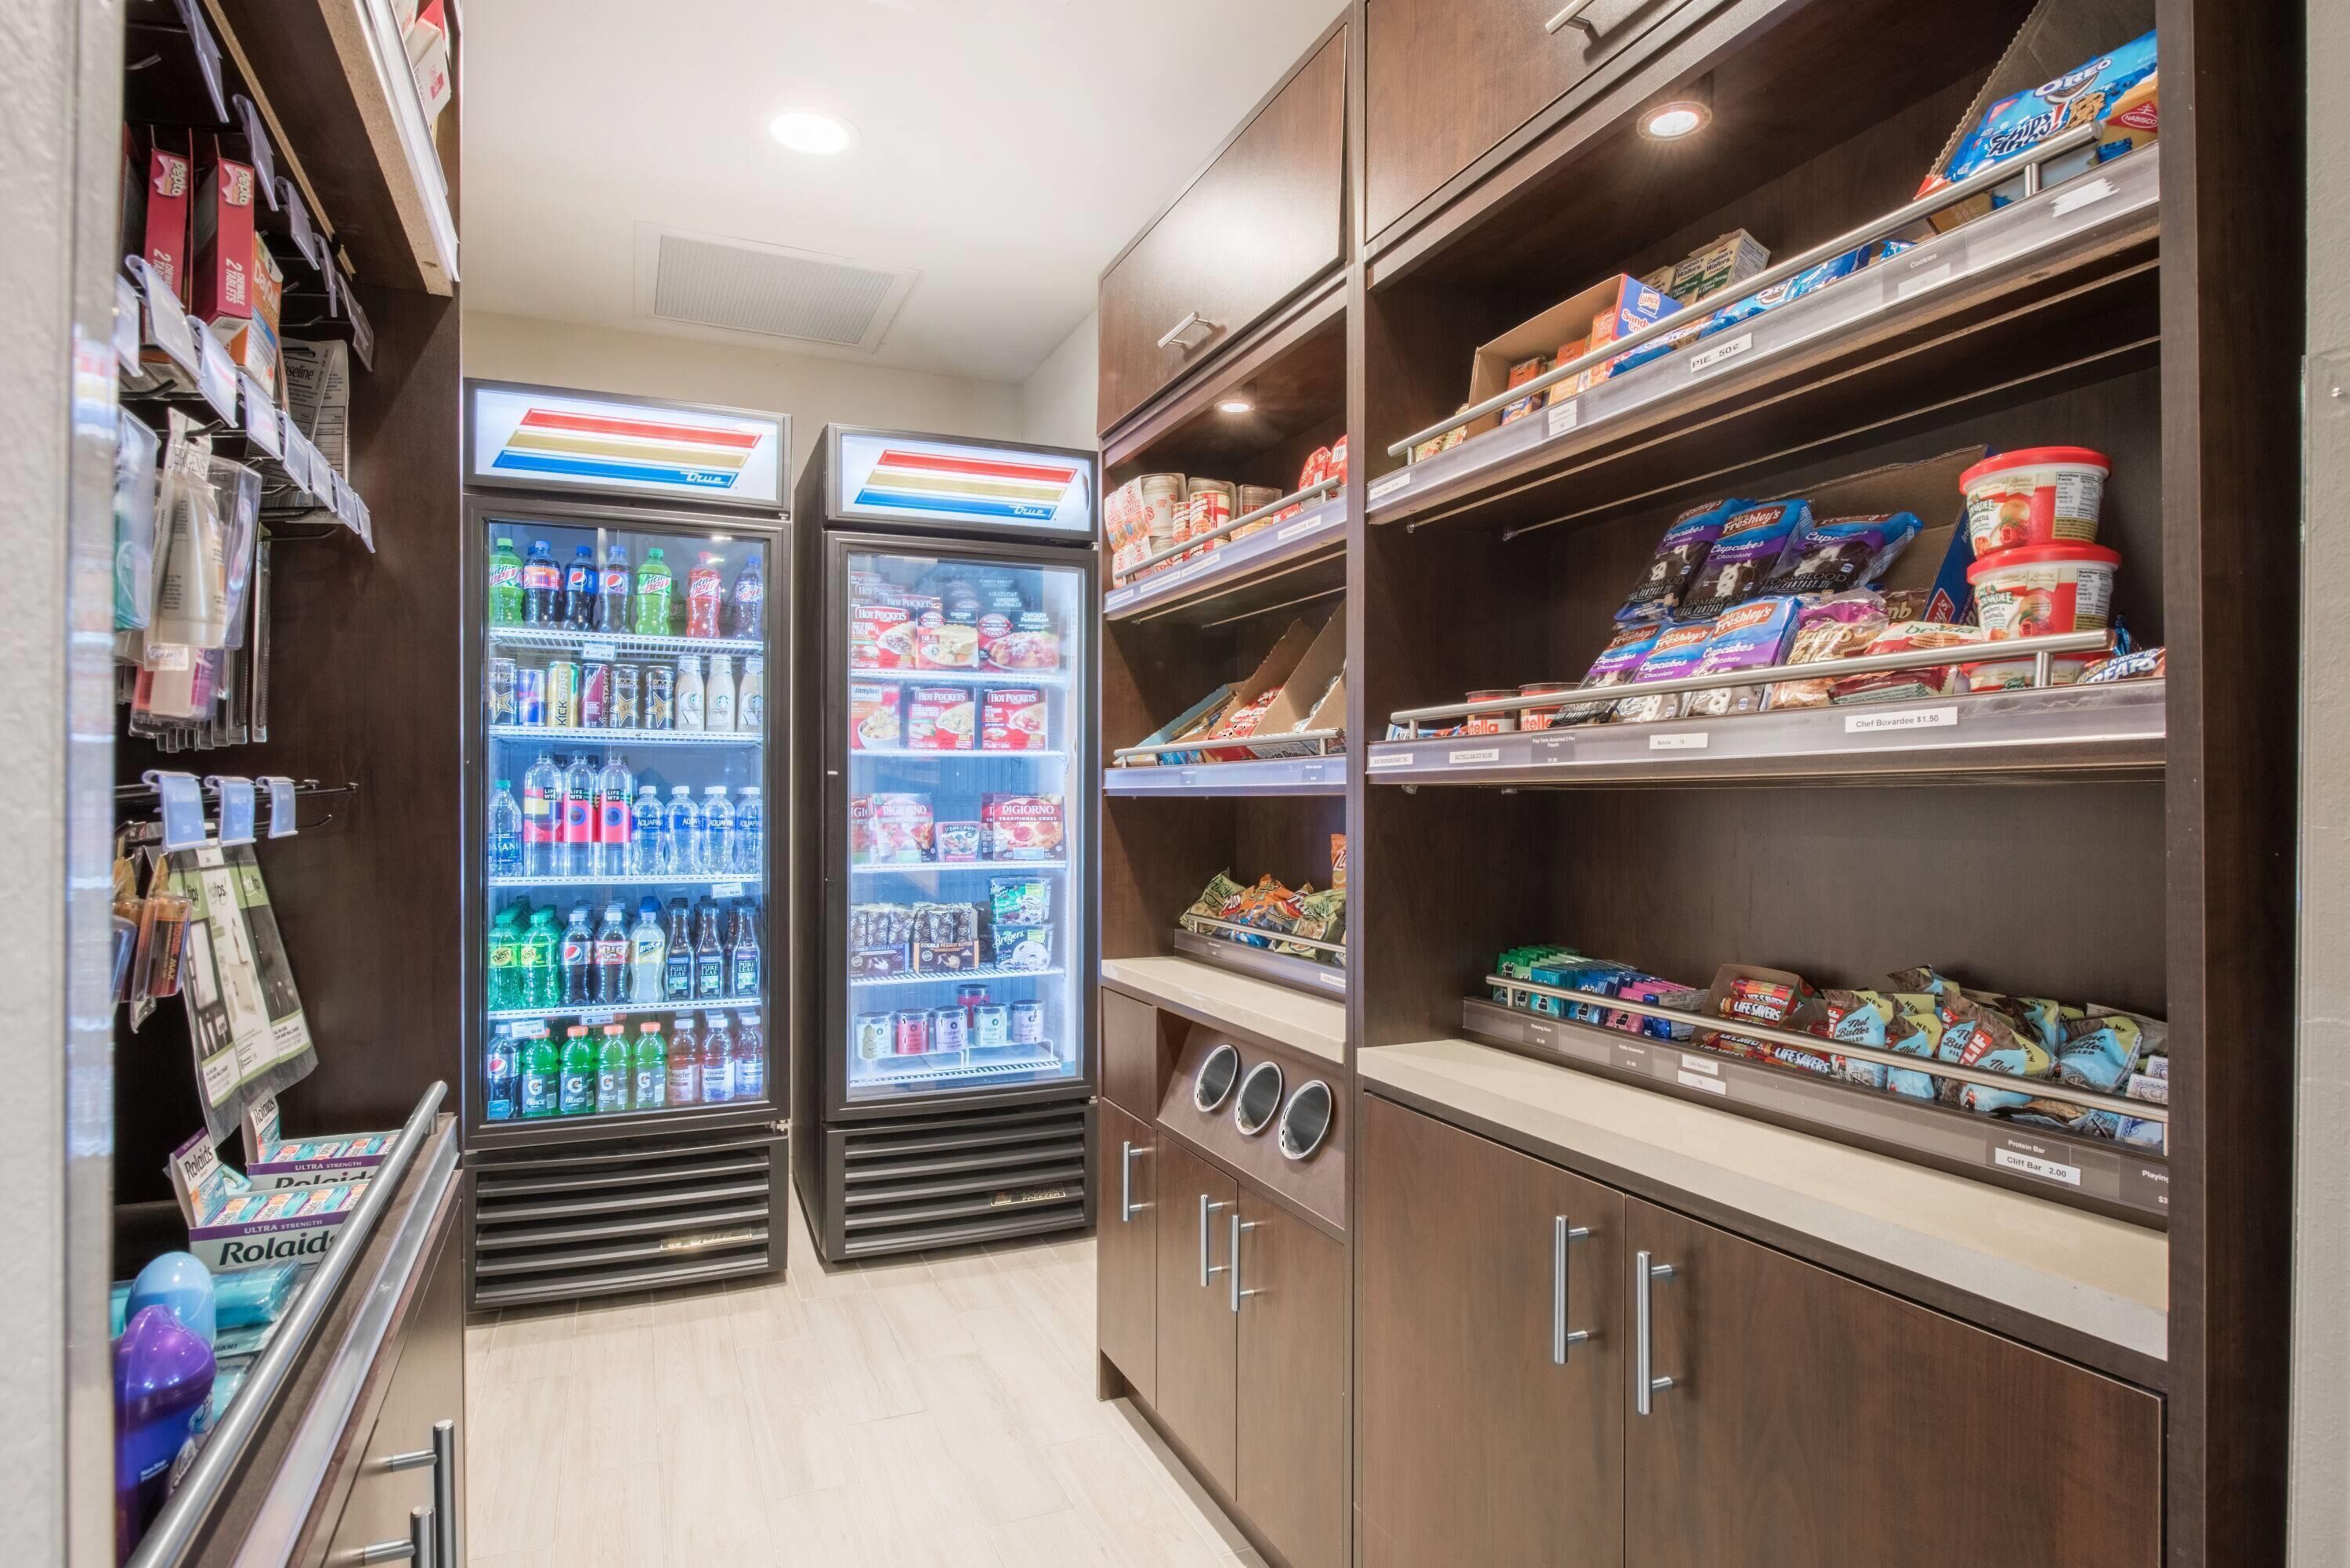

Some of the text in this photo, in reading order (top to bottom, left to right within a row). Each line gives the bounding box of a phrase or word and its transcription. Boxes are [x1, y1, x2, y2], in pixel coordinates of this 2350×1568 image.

[2033, 59, 2113, 98] OREO
[2124, 114, 2158, 125] NABISCO
[1910, 253, 1937, 269] Cookies
[1692, 355, 1712, 368] PIE
[1723, 509, 1781, 534] Freshley's
[1663, 526, 1705, 542] Cupcakes
[1710, 540, 1765, 555] Cupcakes
[1716, 551, 1752, 560] Chocolate
[902, 598, 933, 608] POCKETS
[877, 610, 907, 621] POCKETS
[1715, 607, 1772, 633] Freshley's
[1653, 630, 1708, 651] Freshley's
[1702, 642, 1755, 659] Cupcakes
[1595, 652, 1637, 665] Cupcakes
[1640, 659, 1687, 672] Cupcakes
[1643, 670, 1675, 679] Chocolate
[934, 692, 966, 702] POCKETS
[990, 693, 1037, 703] HOT POCKETS
[1856, 714, 1940, 728] Chef Boyardee $1.50
[637, 818, 663, 827] AQUAFINA
[709, 818, 734, 827] AQUAFINA
[1865, 996, 1884, 1010] NEW
[1904, 1000, 1922, 1015] NEW
[1847, 1017, 1871, 1028] Nut
[1836, 1027, 1871, 1039] Butter
[2021, 1043, 2036, 1064] NEW
[1989, 1058, 2016, 1073] Nut
[527, 1078, 543, 1096] G
[567, 1076, 583, 1093] G
[600, 1074, 613, 1091] G
[637, 1071, 651, 1089] G
[2008, 1140, 2046, 1155] Protein Bar
[184, 1143, 214, 1182] Rolaids
[295, 1162, 324, 1172] ULTRA
[2007, 1156, 2067, 1178] Cliff Bar 2.00
[244, 1219, 324, 1234] ULTRA STRENGTH
